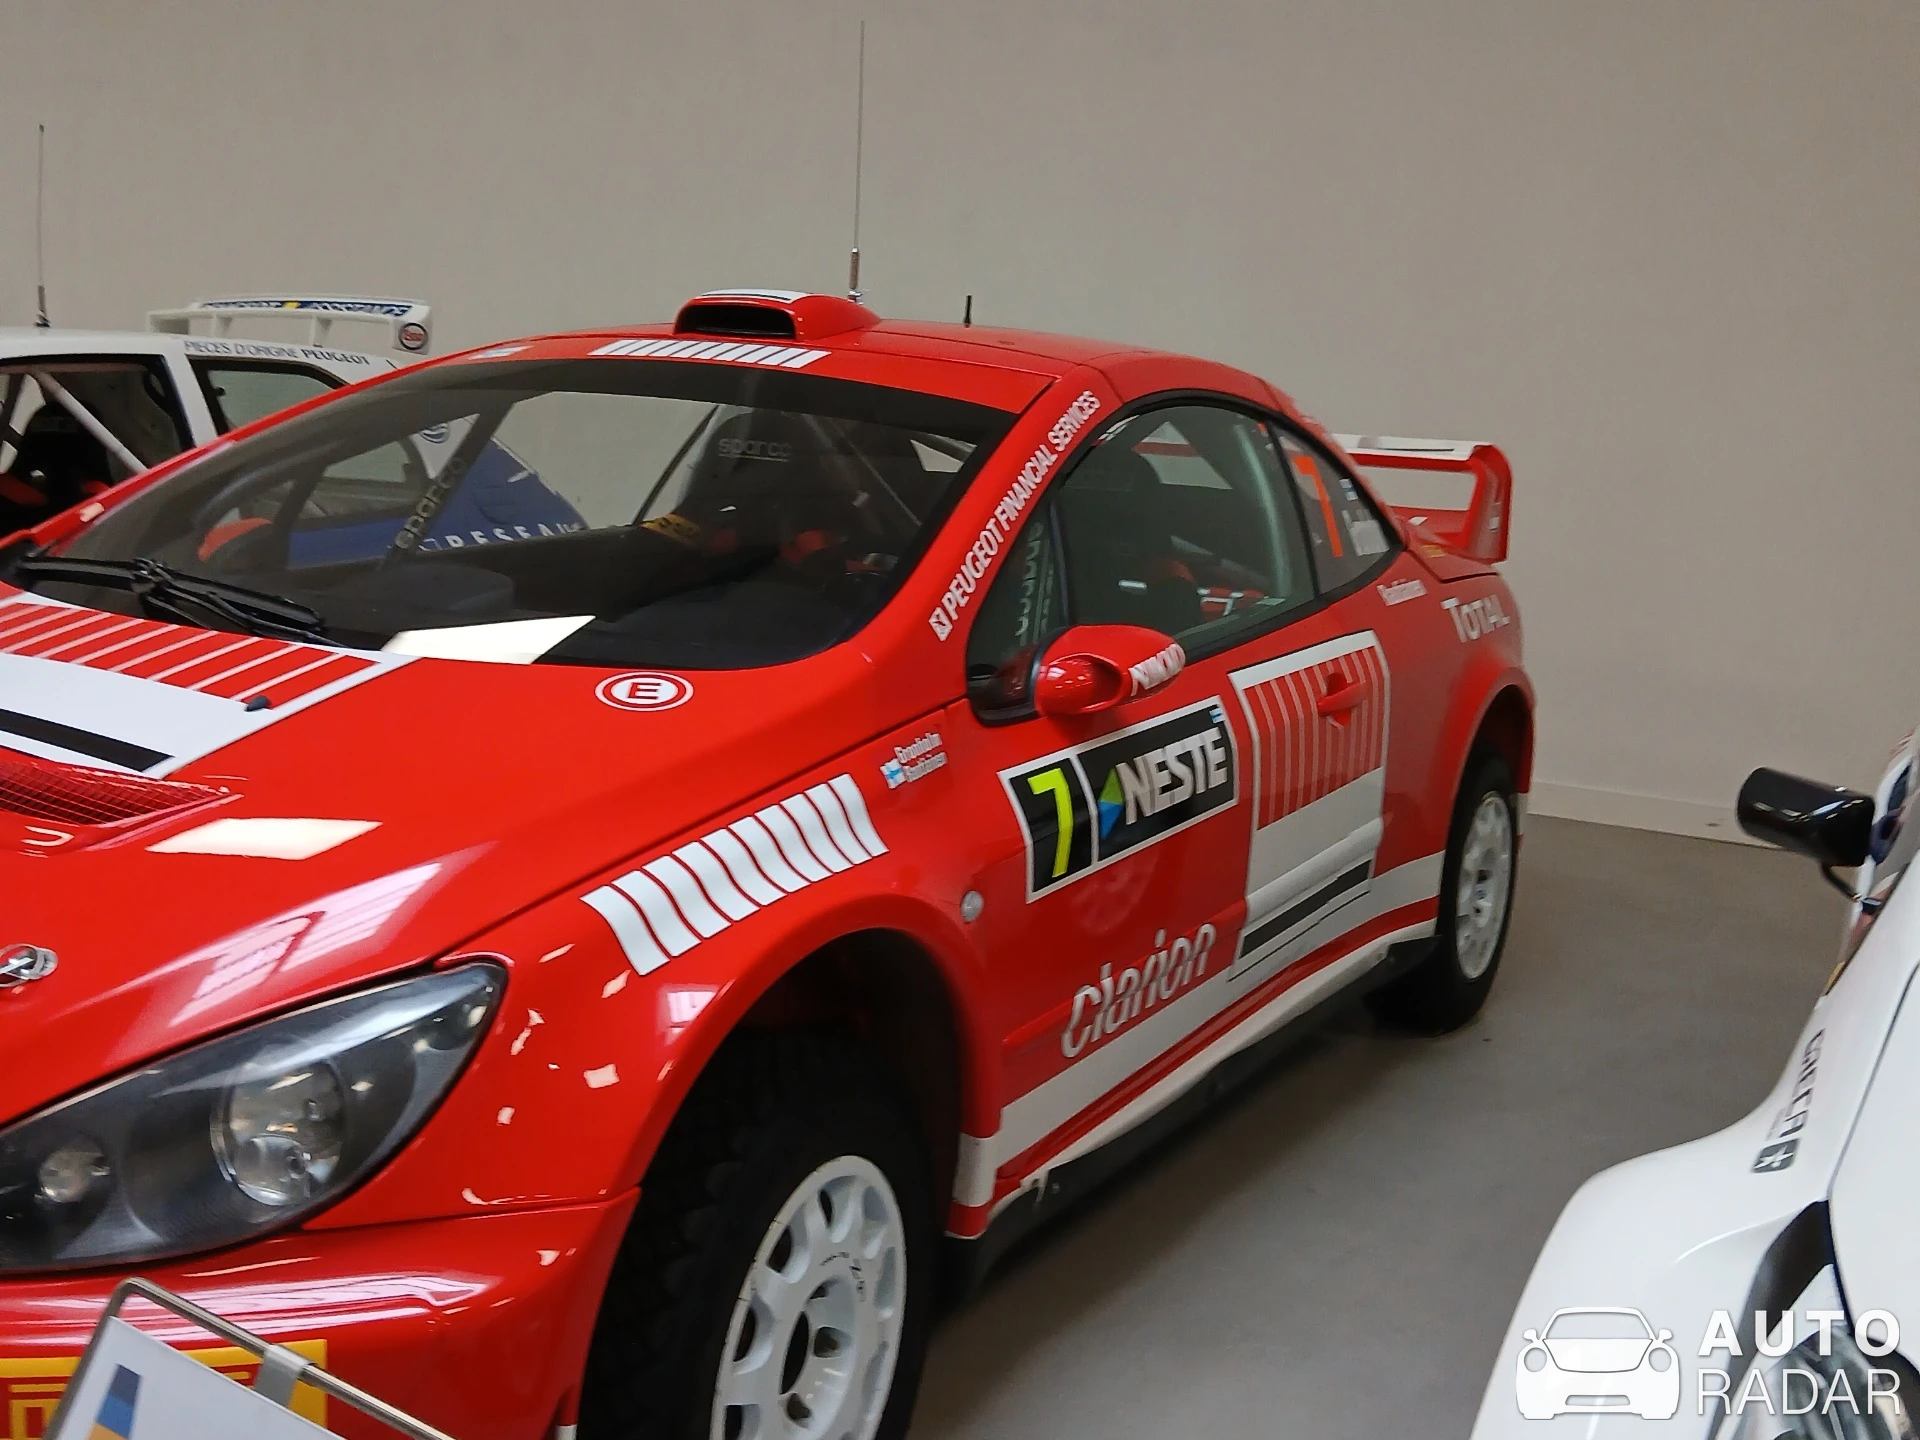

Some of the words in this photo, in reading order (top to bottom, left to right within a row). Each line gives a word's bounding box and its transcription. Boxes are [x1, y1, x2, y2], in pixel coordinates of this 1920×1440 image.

[300, 348, 371, 366] PEUGEOT
[941, 517, 1005, 621] PEUGEOT
[993, 443, 1059, 532] FINANCIAL
[1047, 389, 1101, 452] SERVICES
[1293, 456, 1344, 558] 7
[1440, 594, 1511, 644] TOTAL
[626, 682, 662, 700] E
[1027, 767, 1074, 878] 7
[1115, 726, 1228, 826] NESTE
